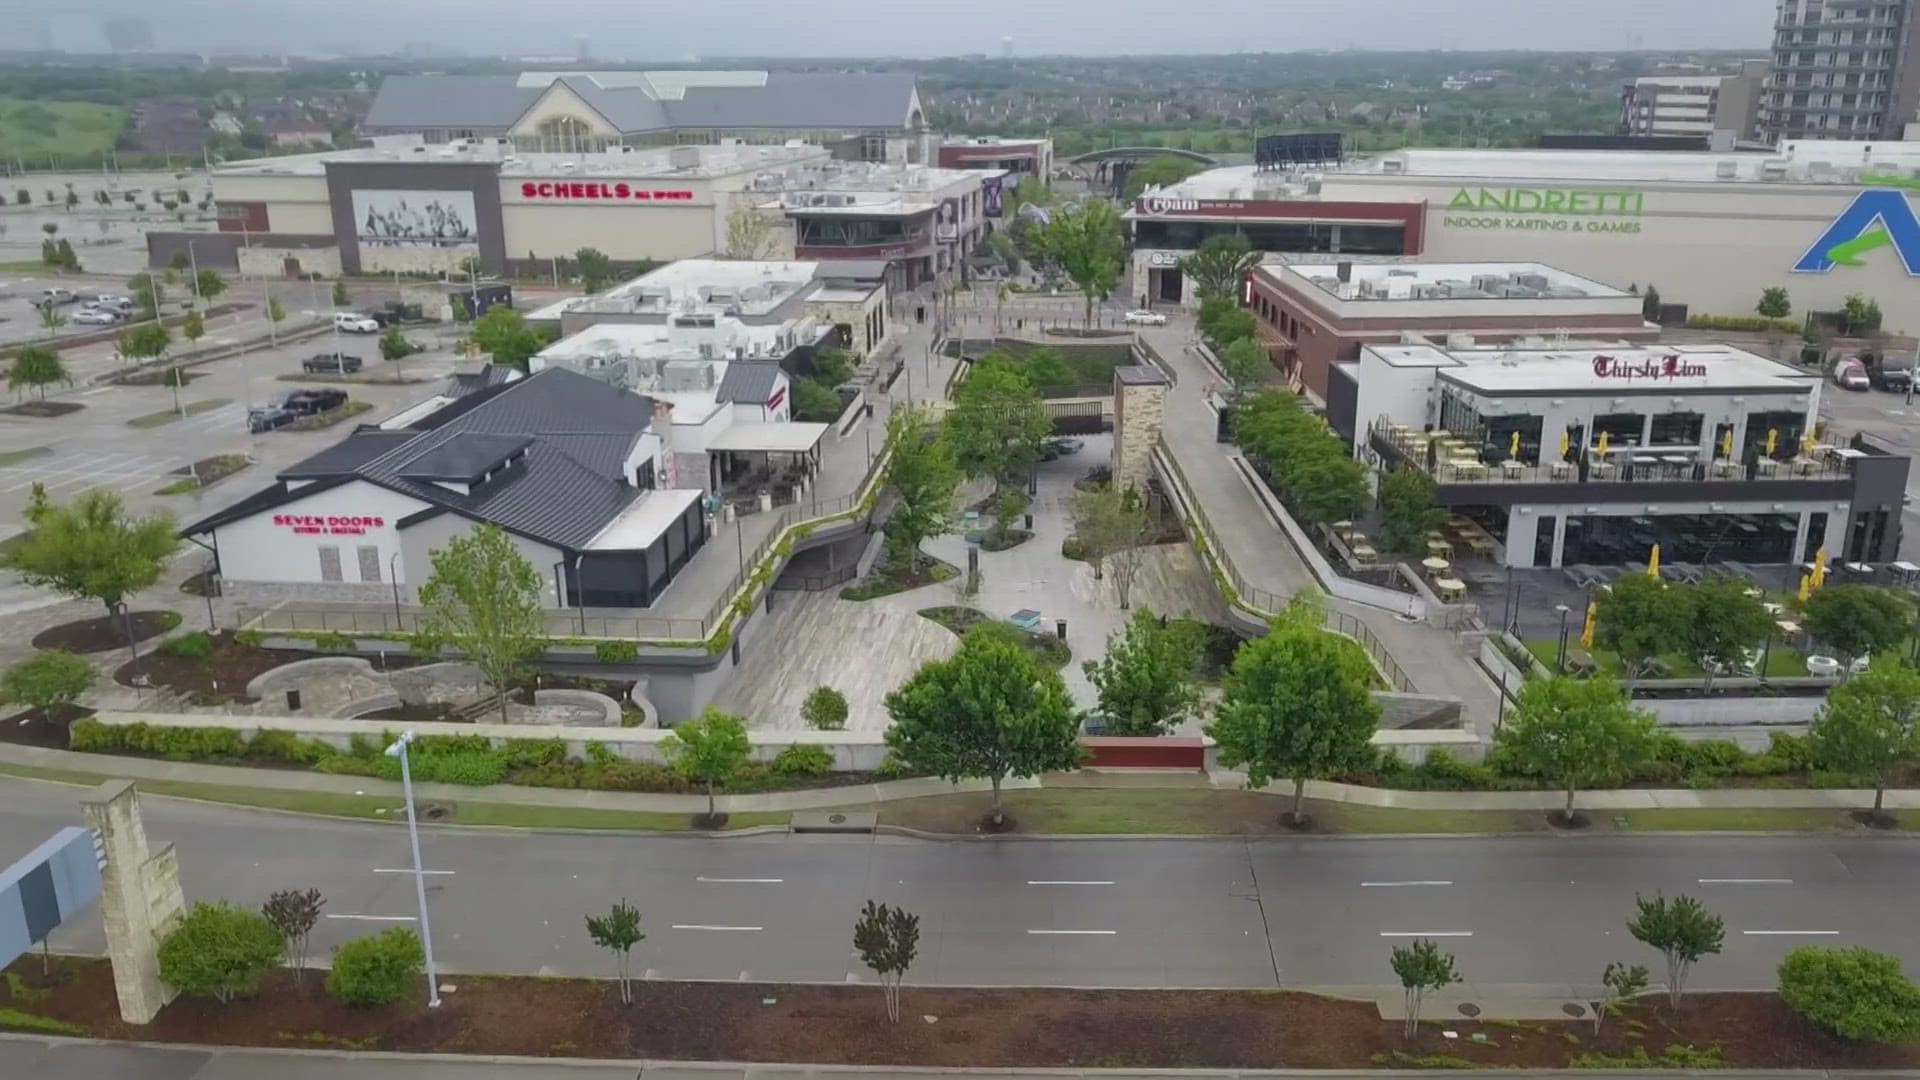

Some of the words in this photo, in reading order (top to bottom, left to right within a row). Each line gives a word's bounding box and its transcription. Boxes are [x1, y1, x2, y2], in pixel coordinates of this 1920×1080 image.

[521, 182, 631, 198] SCHEELS
[1448, 186, 1644, 216] ANDRETTI
[1444, 216, 1502, 229] INDOOR
[1505, 218, 1568, 232] KARTING
[1572, 220, 1583, 233] &
[1587, 221, 1641, 234] GAMES
[1592, 355, 1660, 383] Thirsty
[1660, 354, 1707, 382] Lion
[273, 515, 325, 526] SEVEN
[328, 516, 384, 527] DOORS
